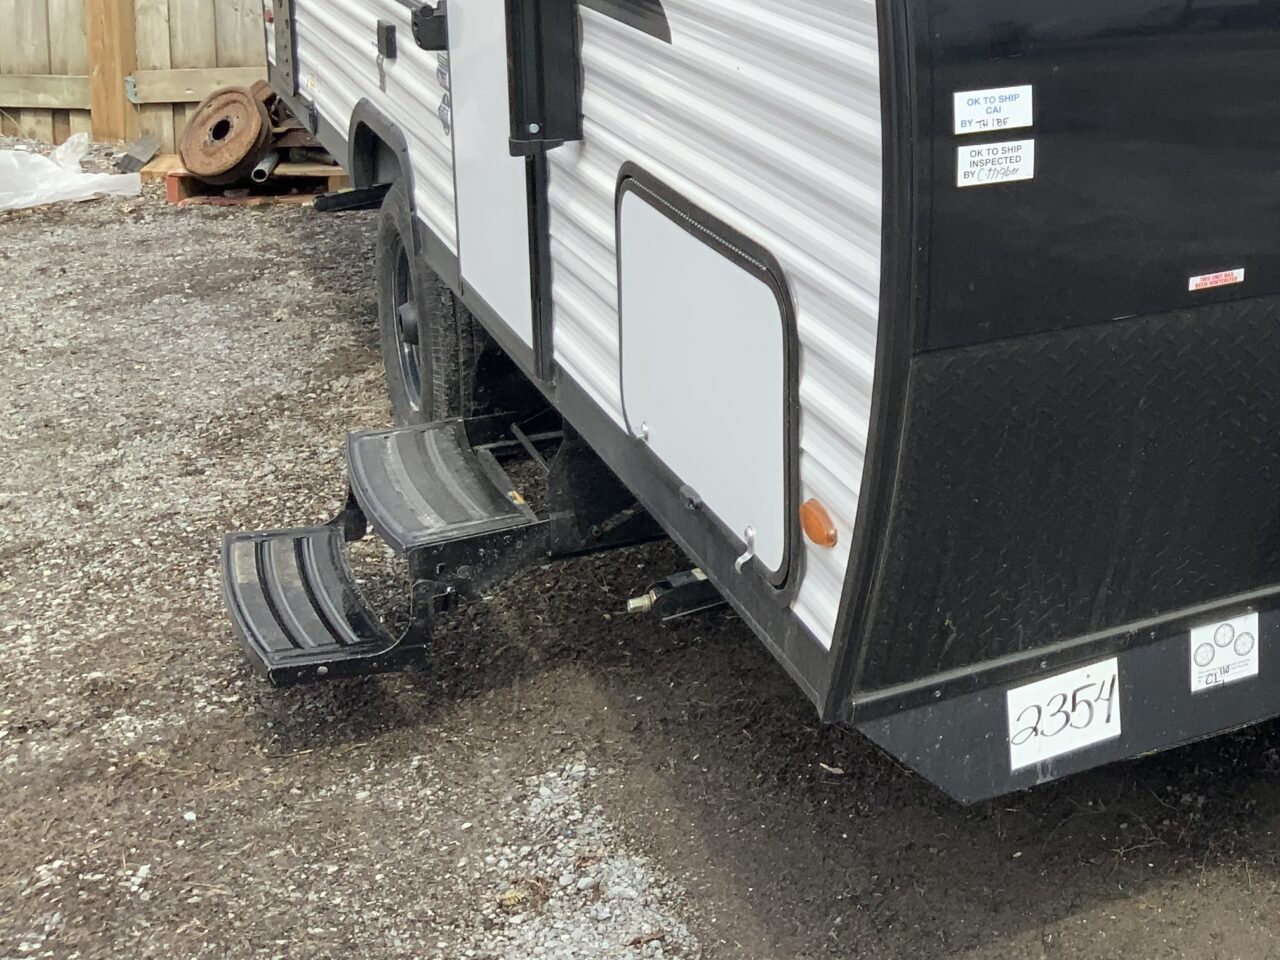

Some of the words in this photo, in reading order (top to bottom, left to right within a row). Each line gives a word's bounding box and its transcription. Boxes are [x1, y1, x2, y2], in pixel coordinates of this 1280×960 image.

[967, 98, 980, 106] OK
[983, 95, 996, 105] TO
[998, 93, 1020, 103] SHIP
[960, 118, 974, 128] BY
[969, 149, 984, 158] OK
[986, 147, 999, 156] TO
[1001, 145, 1022, 155] SHIP
[969, 155, 1022, 168] INSPECTED
[963, 170, 976, 179] BY
[1010, 673, 1117, 746] 2354
